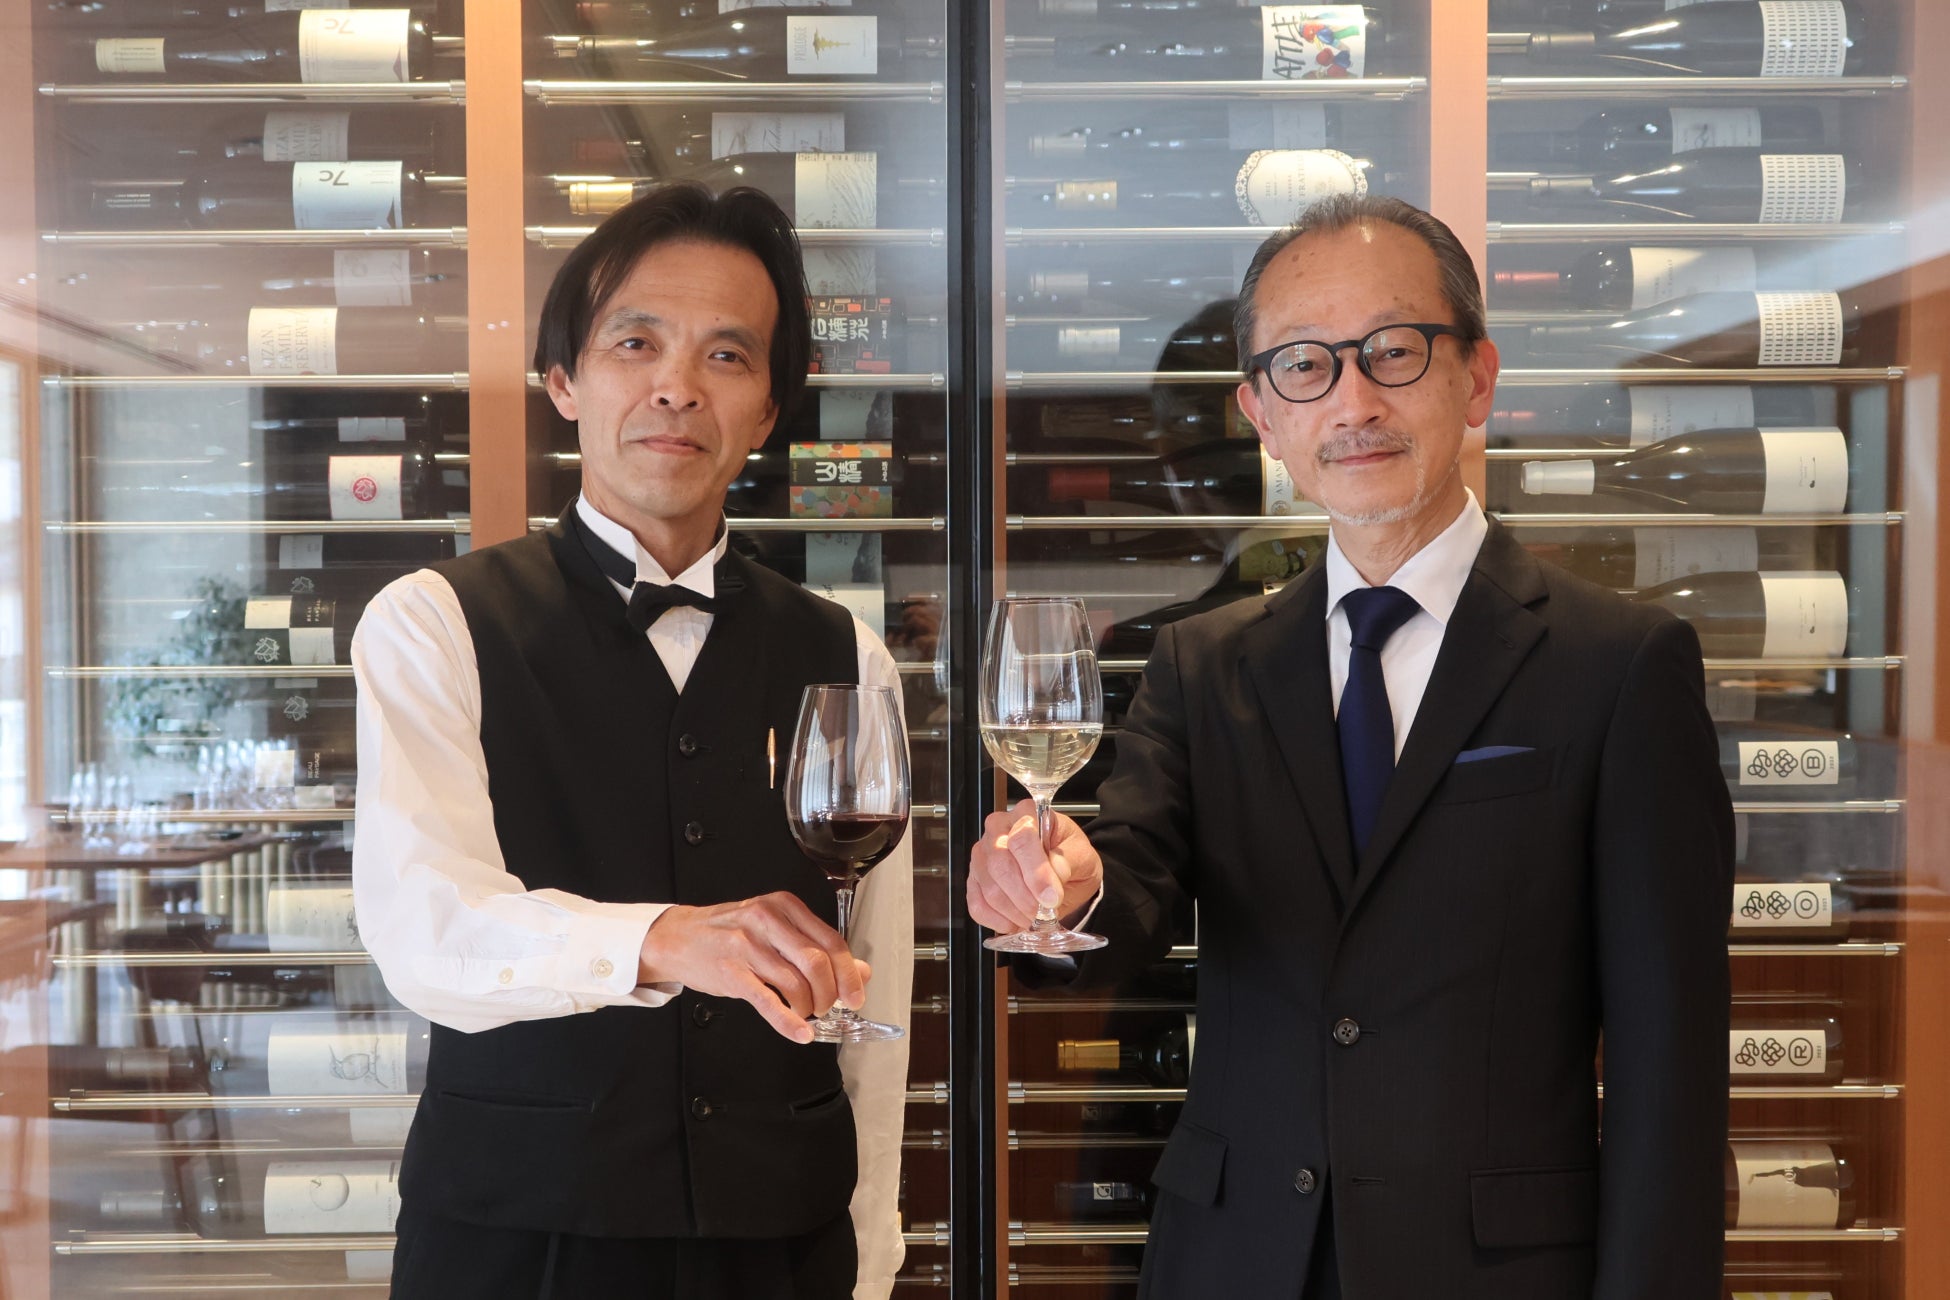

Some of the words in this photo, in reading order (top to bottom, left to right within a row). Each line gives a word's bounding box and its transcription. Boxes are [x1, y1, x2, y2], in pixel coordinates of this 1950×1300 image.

[323, 18, 355, 34] 7c
[276, 127, 288, 161] IZAN
[292, 121, 305, 161] AMILY
[319, 169, 350, 187] 7c
[261, 329, 275, 369] KIZAN
[278, 322, 292, 369] FAMILY
[295, 316, 309, 369] RESERVE
[1806, 755, 1820, 770] B
[1794, 1045, 1808, 1060] R
